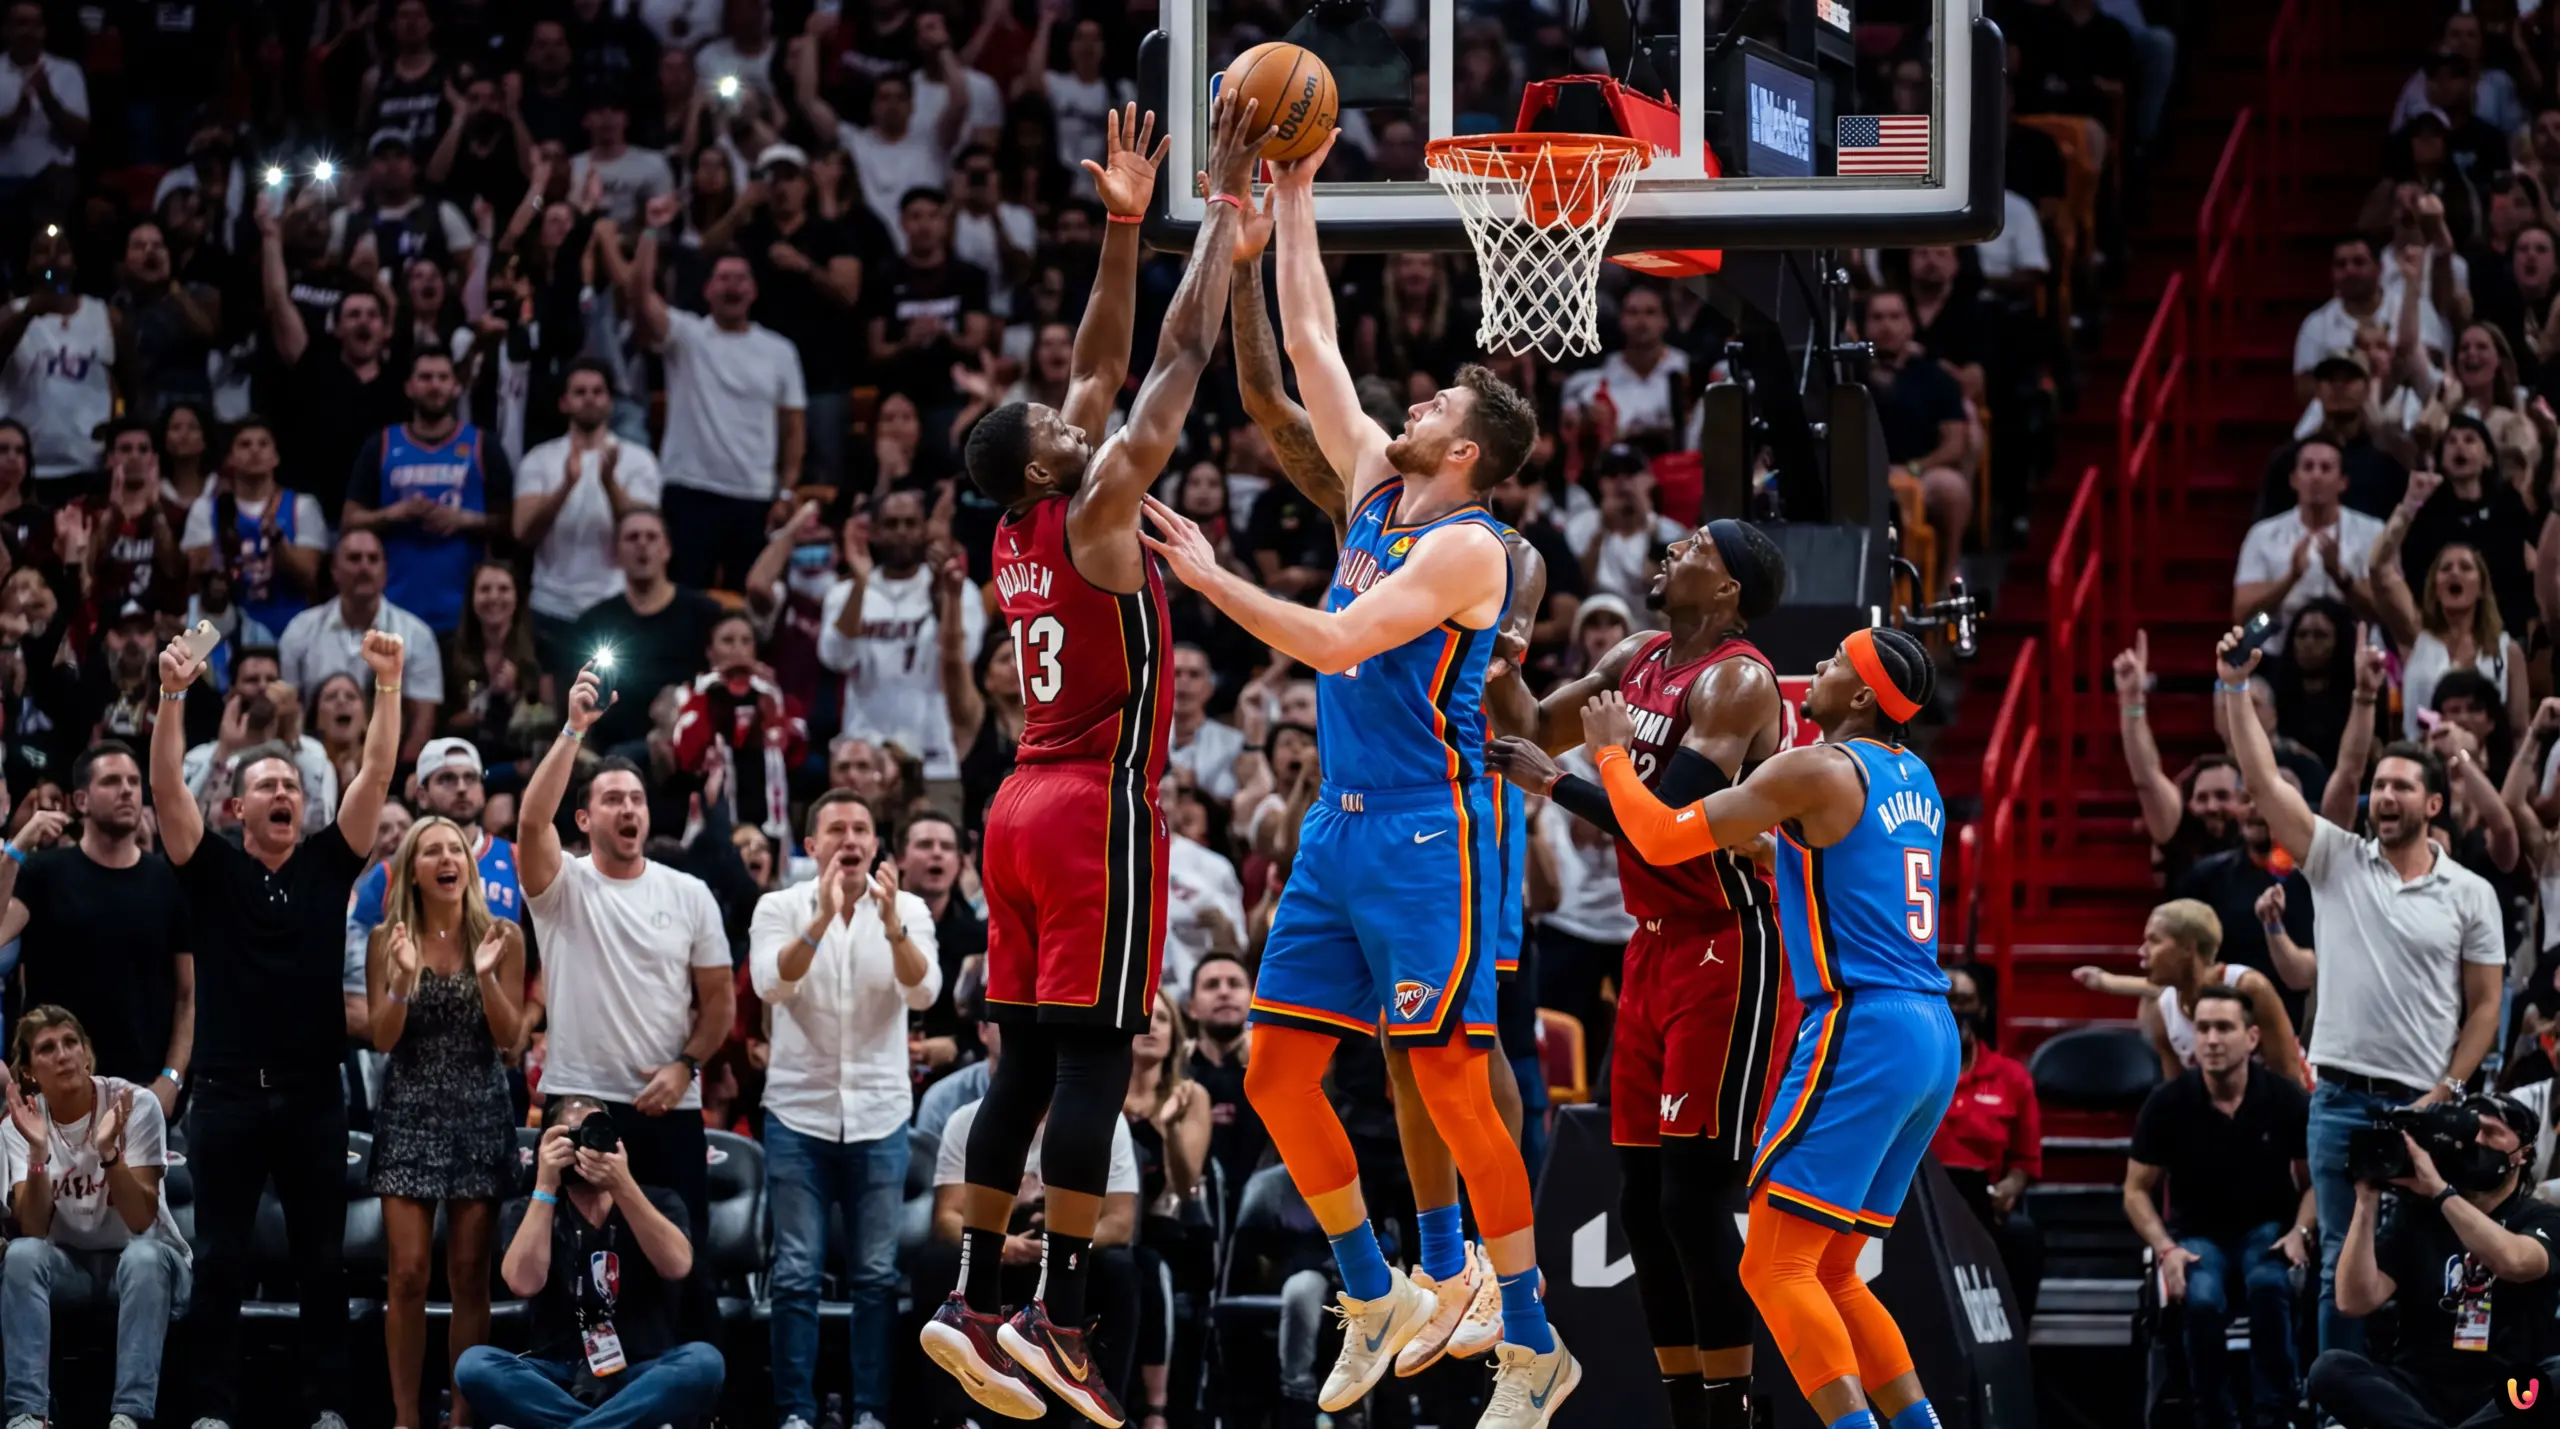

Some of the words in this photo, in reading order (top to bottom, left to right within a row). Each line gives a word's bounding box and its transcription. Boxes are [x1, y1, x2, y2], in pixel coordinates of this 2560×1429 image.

[1276, 75, 1318, 141] Wilson
[1010, 614, 1065, 706] 13
[1904, 847, 1935, 944] 5
